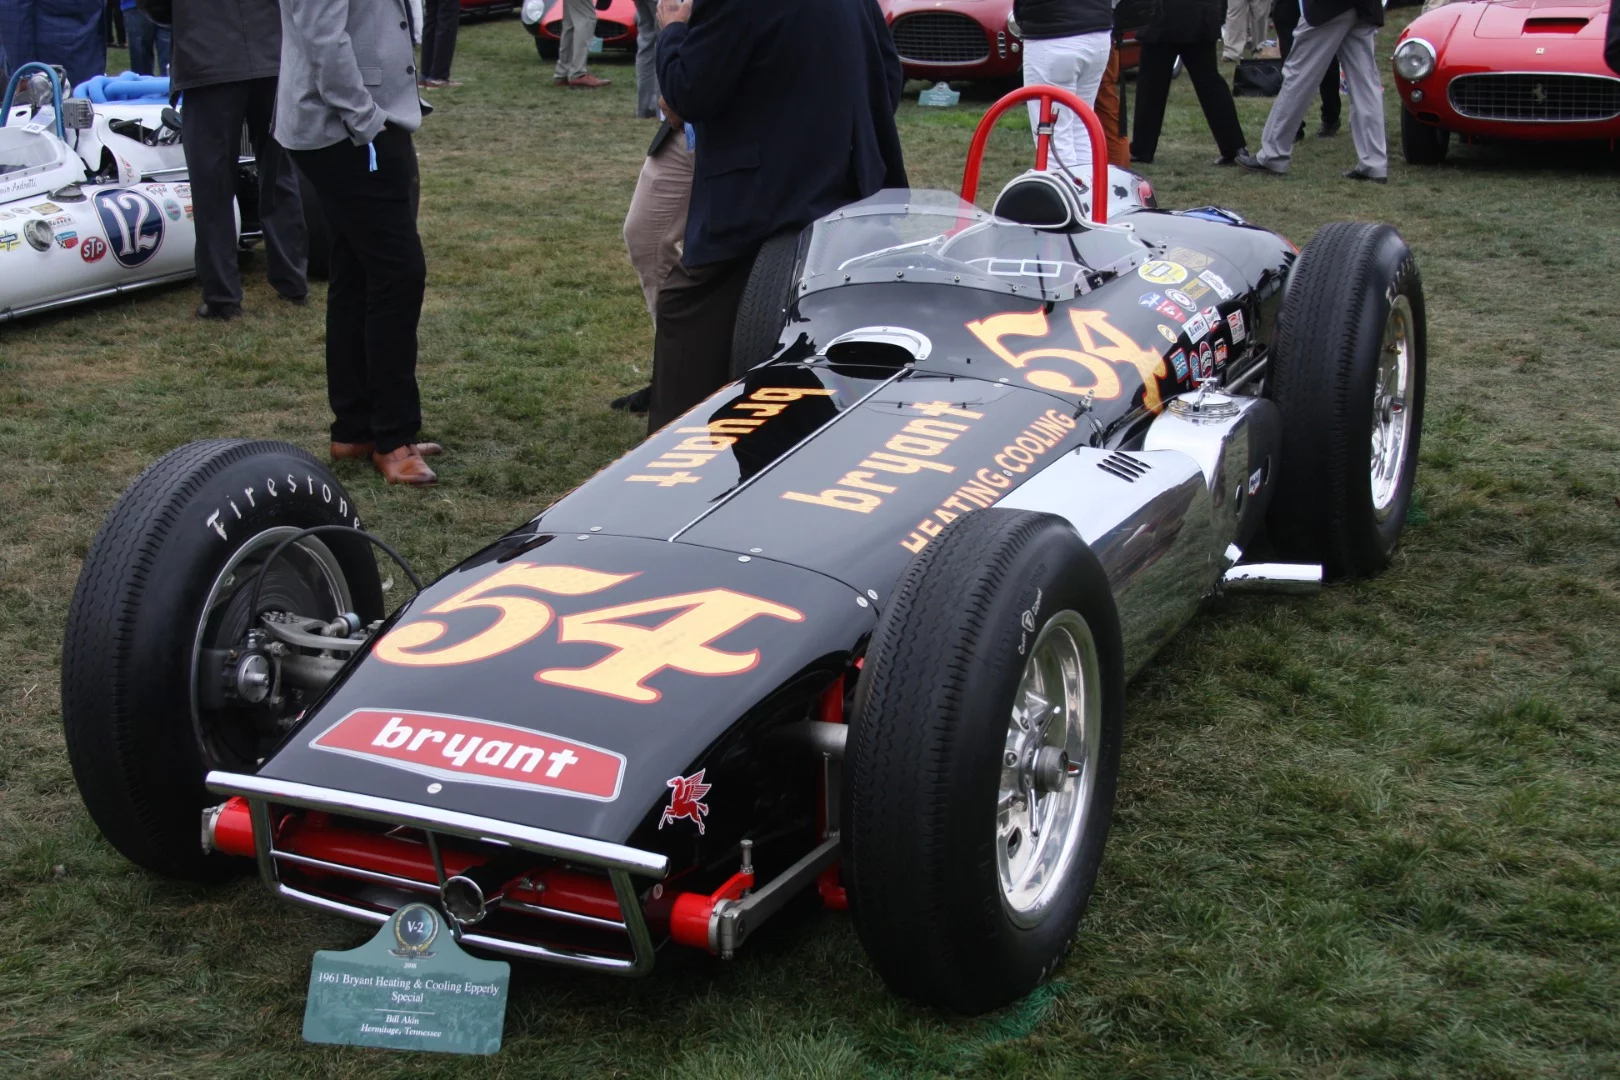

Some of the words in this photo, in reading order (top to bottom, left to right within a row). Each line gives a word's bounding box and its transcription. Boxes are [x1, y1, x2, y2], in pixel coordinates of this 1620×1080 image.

[83, 238, 104, 258] STP
[101, 192, 158, 256] 12
[964, 304, 1168, 415] 54
[624, 386, 838, 488] bryant
[780, 400, 985, 514] bryant
[207, 473, 361, 541] Firestone
[899, 467, 1012, 554] HEATING
[993, 409, 1077, 474] COOLING
[371, 562, 806, 704] 54
[371, 716, 580, 779] bryant
[407, 921, 424, 934] V-2
[319, 972, 340, 983] 1961
[342, 973, 373, 987] Bryant
[375, 976, 411, 990] Heating
[413, 978, 422, 989] &
[425, 979, 462, 994] Cooling
[464, 981, 500, 996] Epperly
[391, 991, 424, 1004] Special
[360, 1023, 402, 1036] Hermitage,
[404, 1026, 442, 1038] Tennessee
[386, 1014, 401, 1023] Bill
[401, 1015, 419, 1025] Akin
